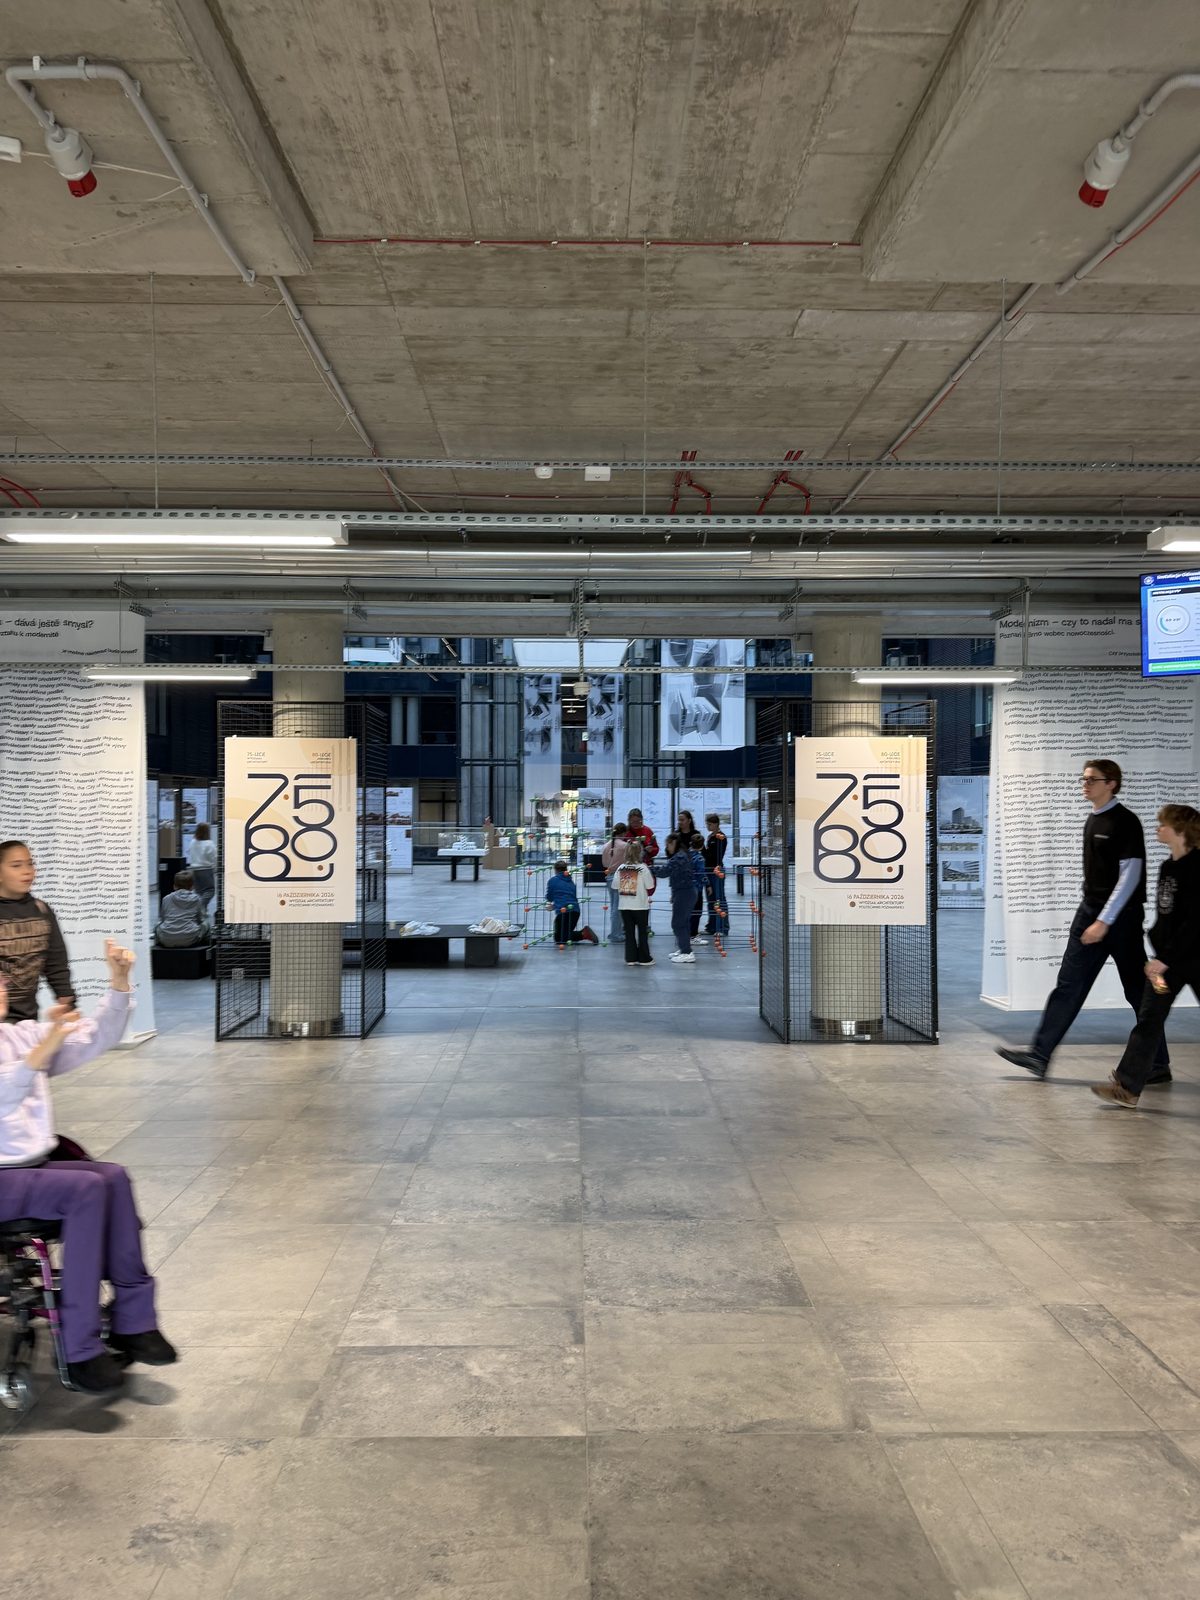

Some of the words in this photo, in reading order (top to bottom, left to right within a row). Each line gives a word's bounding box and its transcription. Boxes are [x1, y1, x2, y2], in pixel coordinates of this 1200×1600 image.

[63, 619, 94, 631] smysl?
[1061, 619, 1077, 628] czy
[1080, 617, 1089, 626] to
[1092, 616, 1116, 626] nadal
